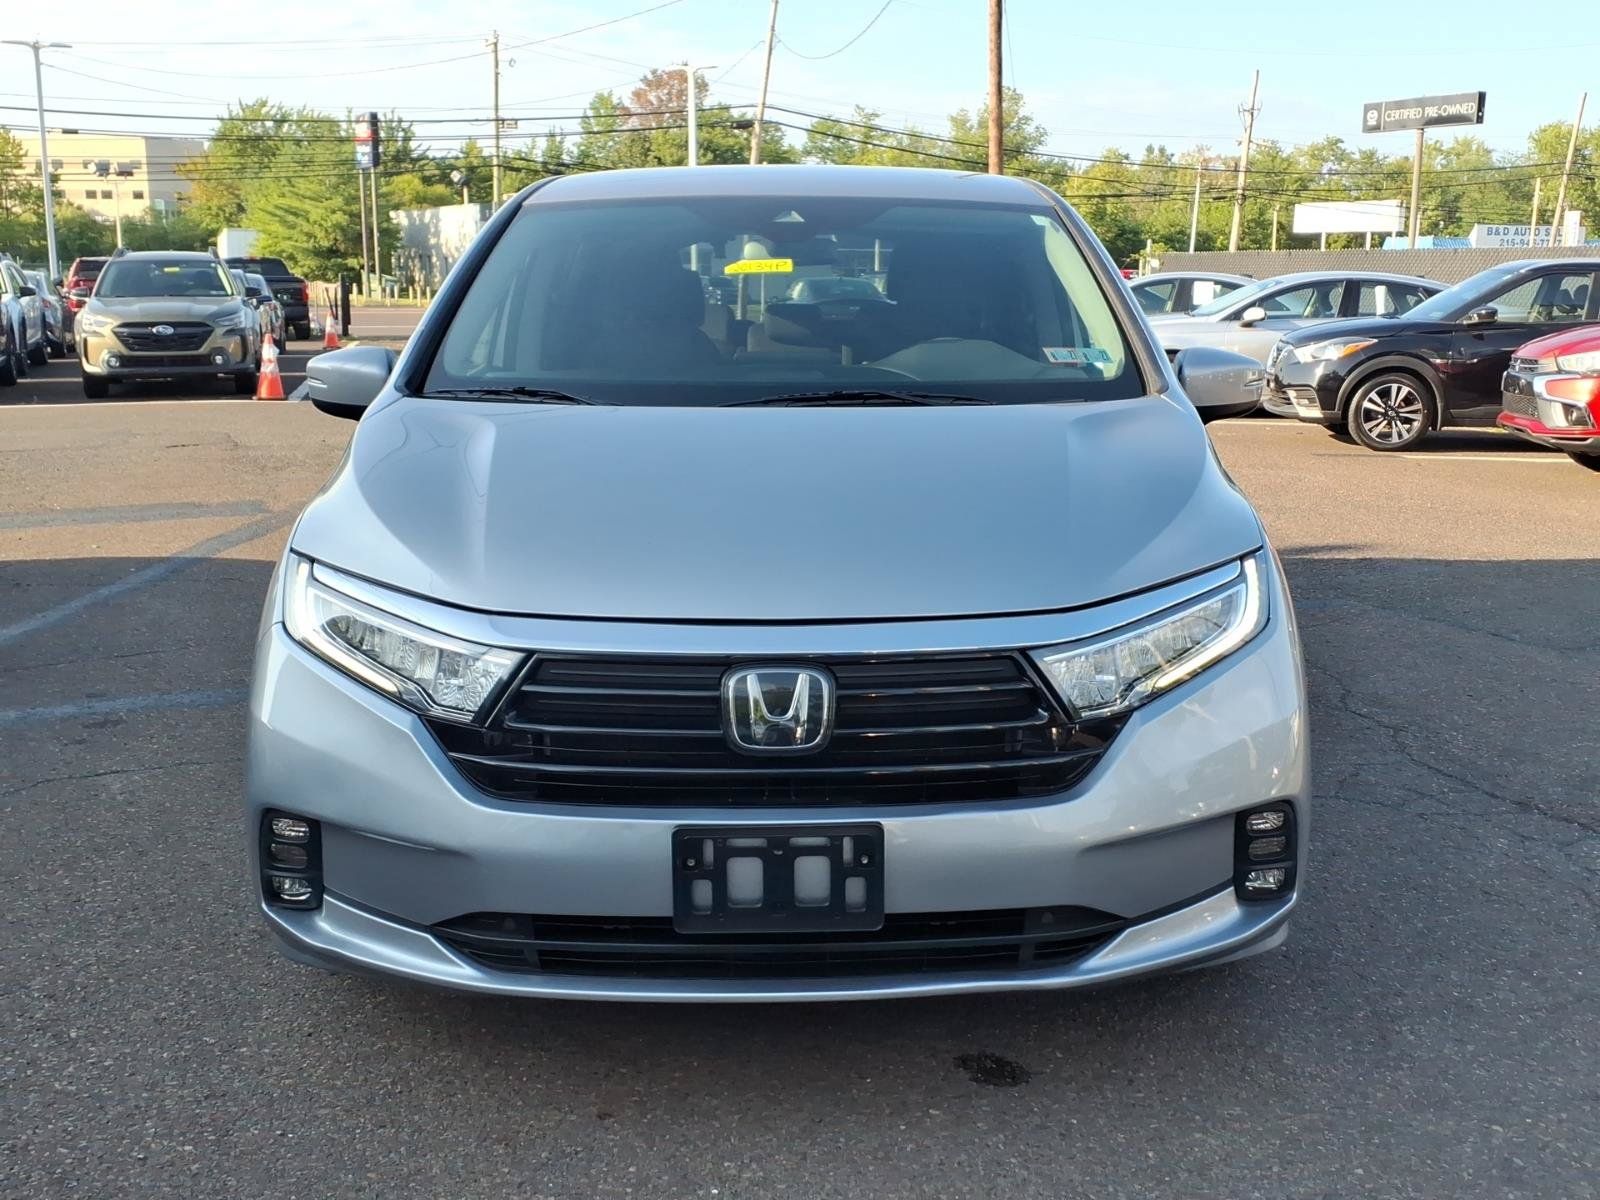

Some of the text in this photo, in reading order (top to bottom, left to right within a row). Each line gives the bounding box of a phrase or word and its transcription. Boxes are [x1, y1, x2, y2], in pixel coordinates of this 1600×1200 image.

[1384, 102, 1476, 122] CERTIFIED PRE-OWNED
[1486, 226, 1510, 237] B&D
